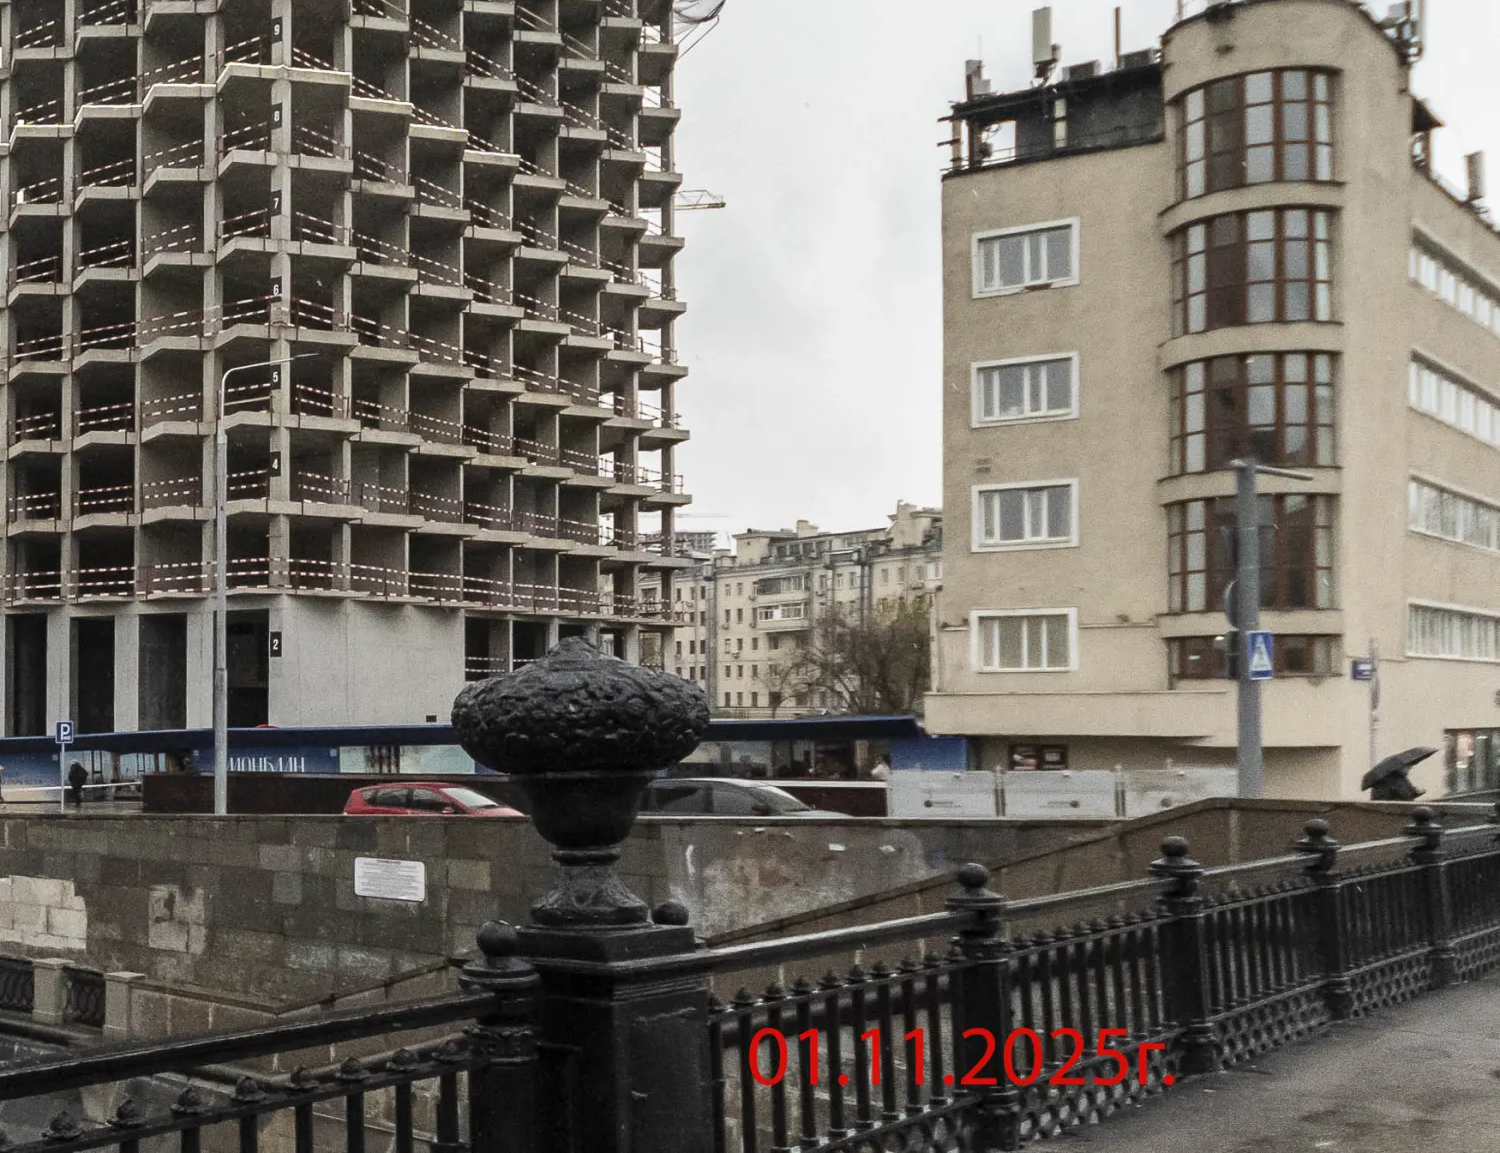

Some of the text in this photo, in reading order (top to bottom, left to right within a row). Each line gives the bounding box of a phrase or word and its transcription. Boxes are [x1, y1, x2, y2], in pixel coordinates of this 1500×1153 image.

[274, 24, 280, 35] 9
[274, 110, 280, 122] 8
[273, 197, 279, 209] 7
[273, 283, 279, 295] 6
[272, 371, 279, 383] 5
[272, 458, 278, 469] 4
[272, 638, 279, 650] 2
